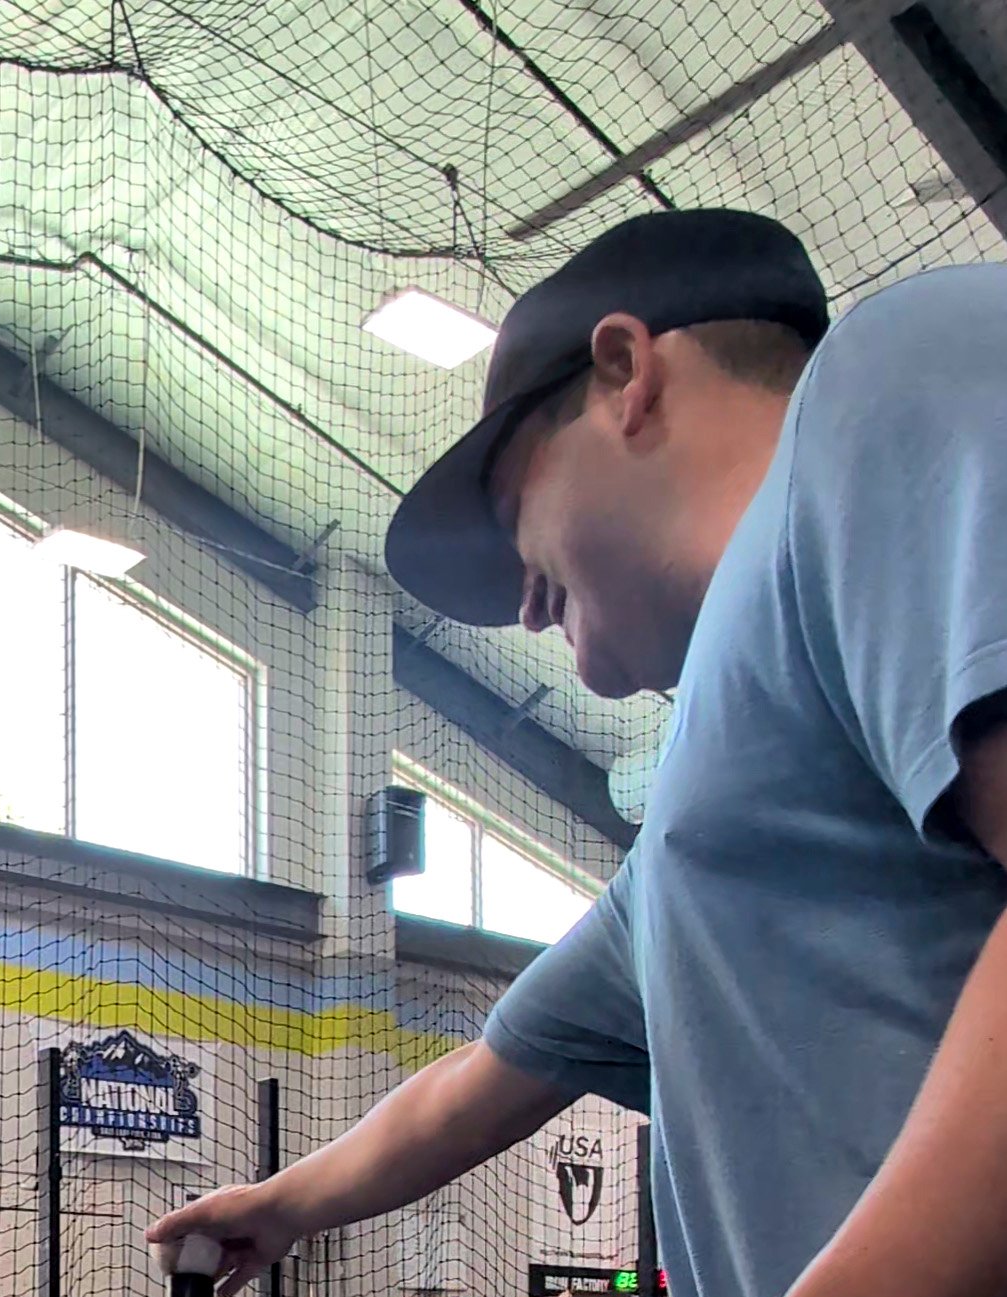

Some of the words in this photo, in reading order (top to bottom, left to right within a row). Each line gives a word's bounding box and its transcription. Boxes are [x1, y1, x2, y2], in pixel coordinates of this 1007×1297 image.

[80, 1077, 180, 1117] NATIONAL
[59, 1105, 196, 1135] CHAMPIONSHIPS
[559, 1134, 604, 1160] USA
